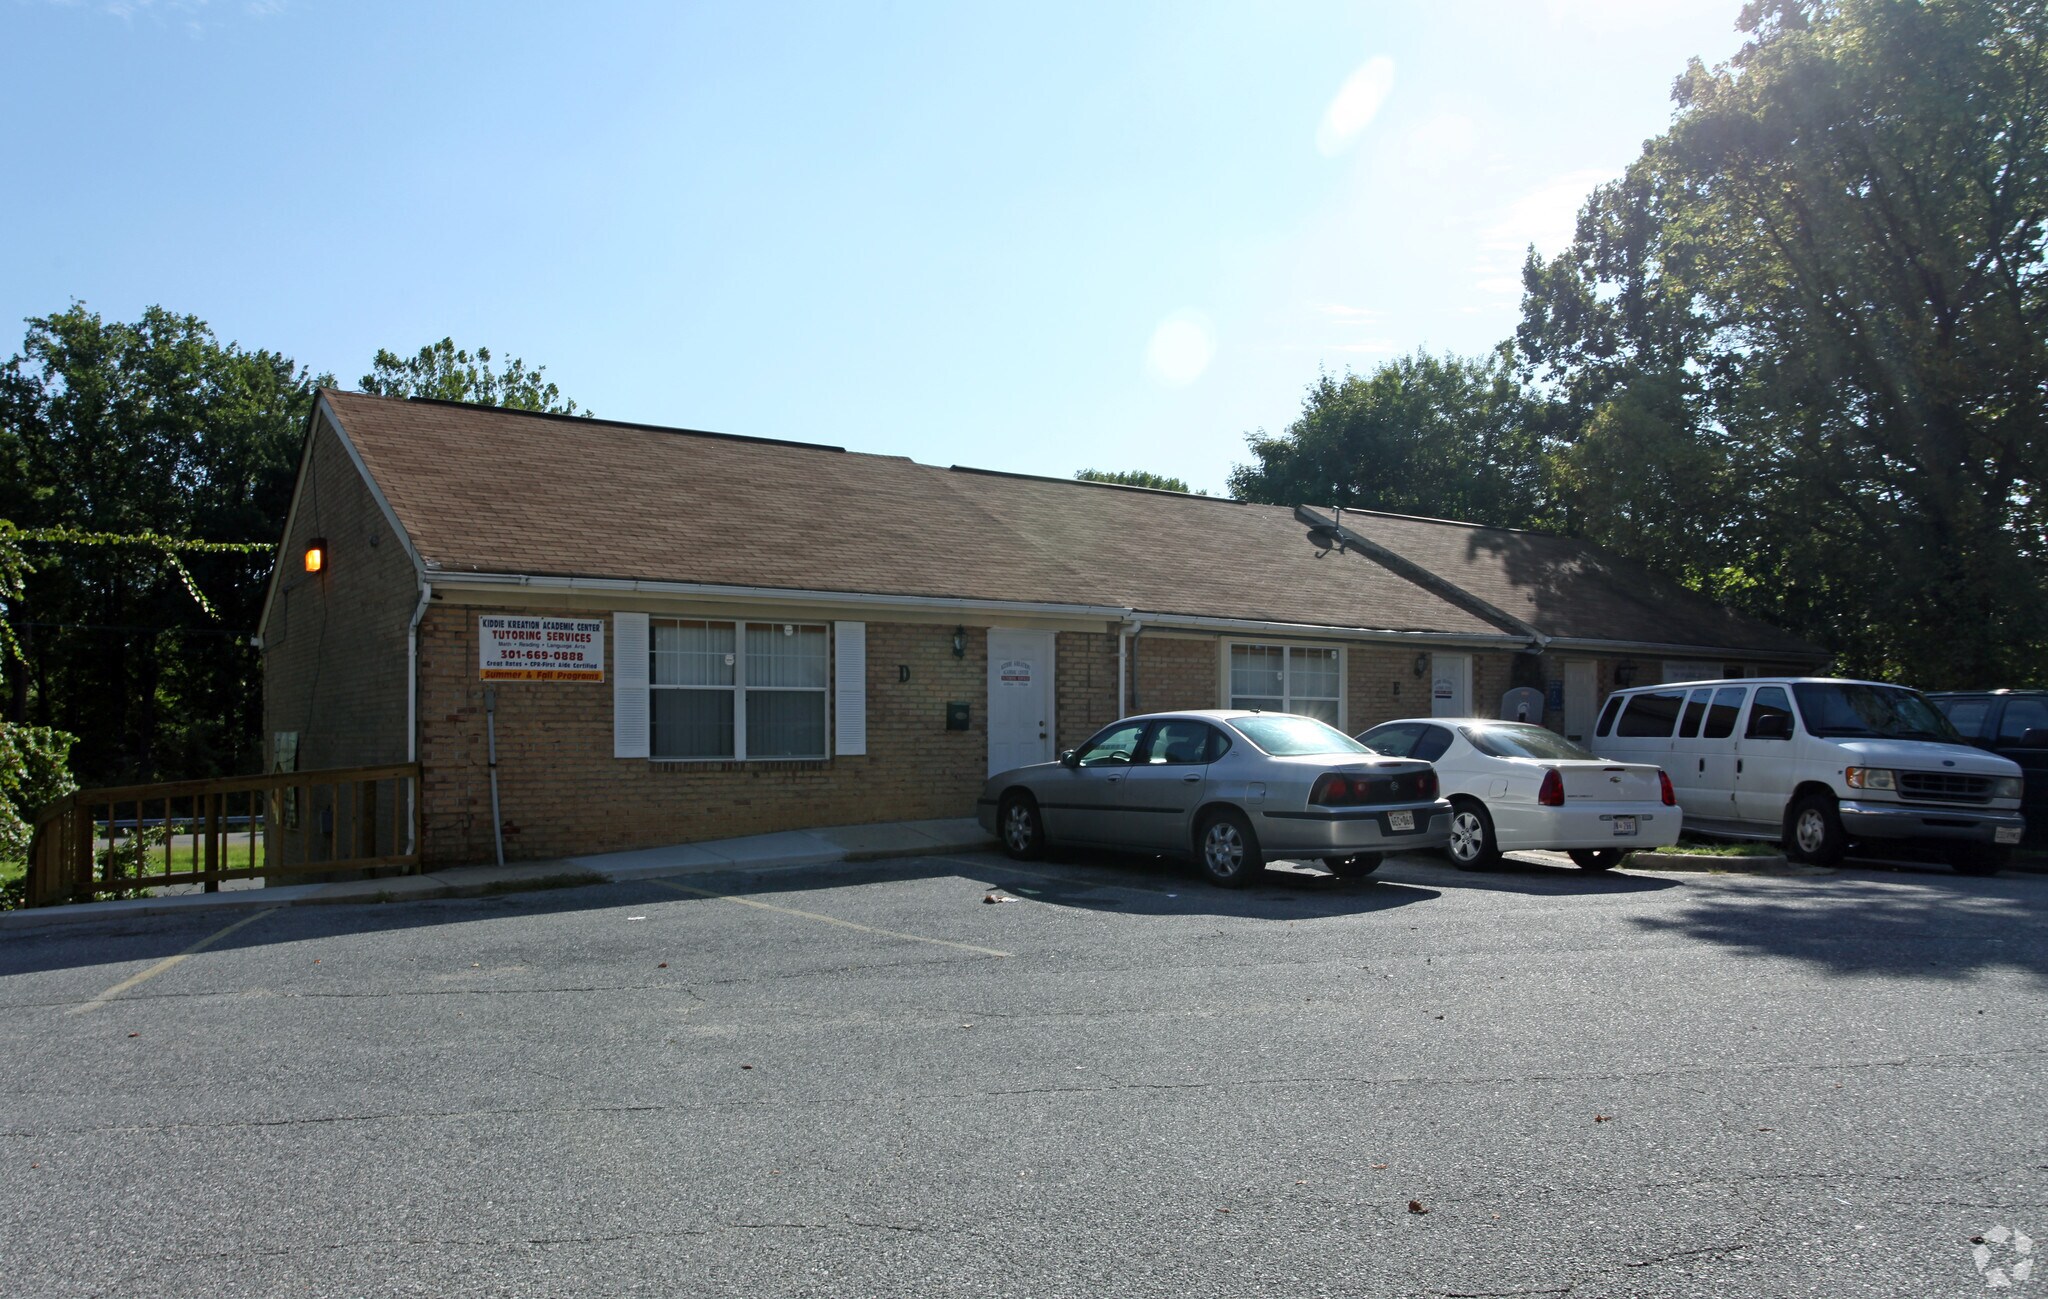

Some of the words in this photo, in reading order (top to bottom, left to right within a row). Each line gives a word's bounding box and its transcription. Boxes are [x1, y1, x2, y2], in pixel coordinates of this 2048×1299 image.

[482, 619, 505, 628] KIDDIE
[507, 620, 540, 630] KREATION
[542, 621, 574, 631] ACADEMIC
[577, 623, 601, 632] CENTER
[492, 630, 542, 640] TUTORING
[546, 631, 592, 643] SERVICES
[501, 650, 584, 661] 301-669-0888
[485, 670, 522, 679] Summer
[537, 671, 553, 679] Fall
[556, 671, 600, 680] Programs
[898, 664, 911, 683] D
